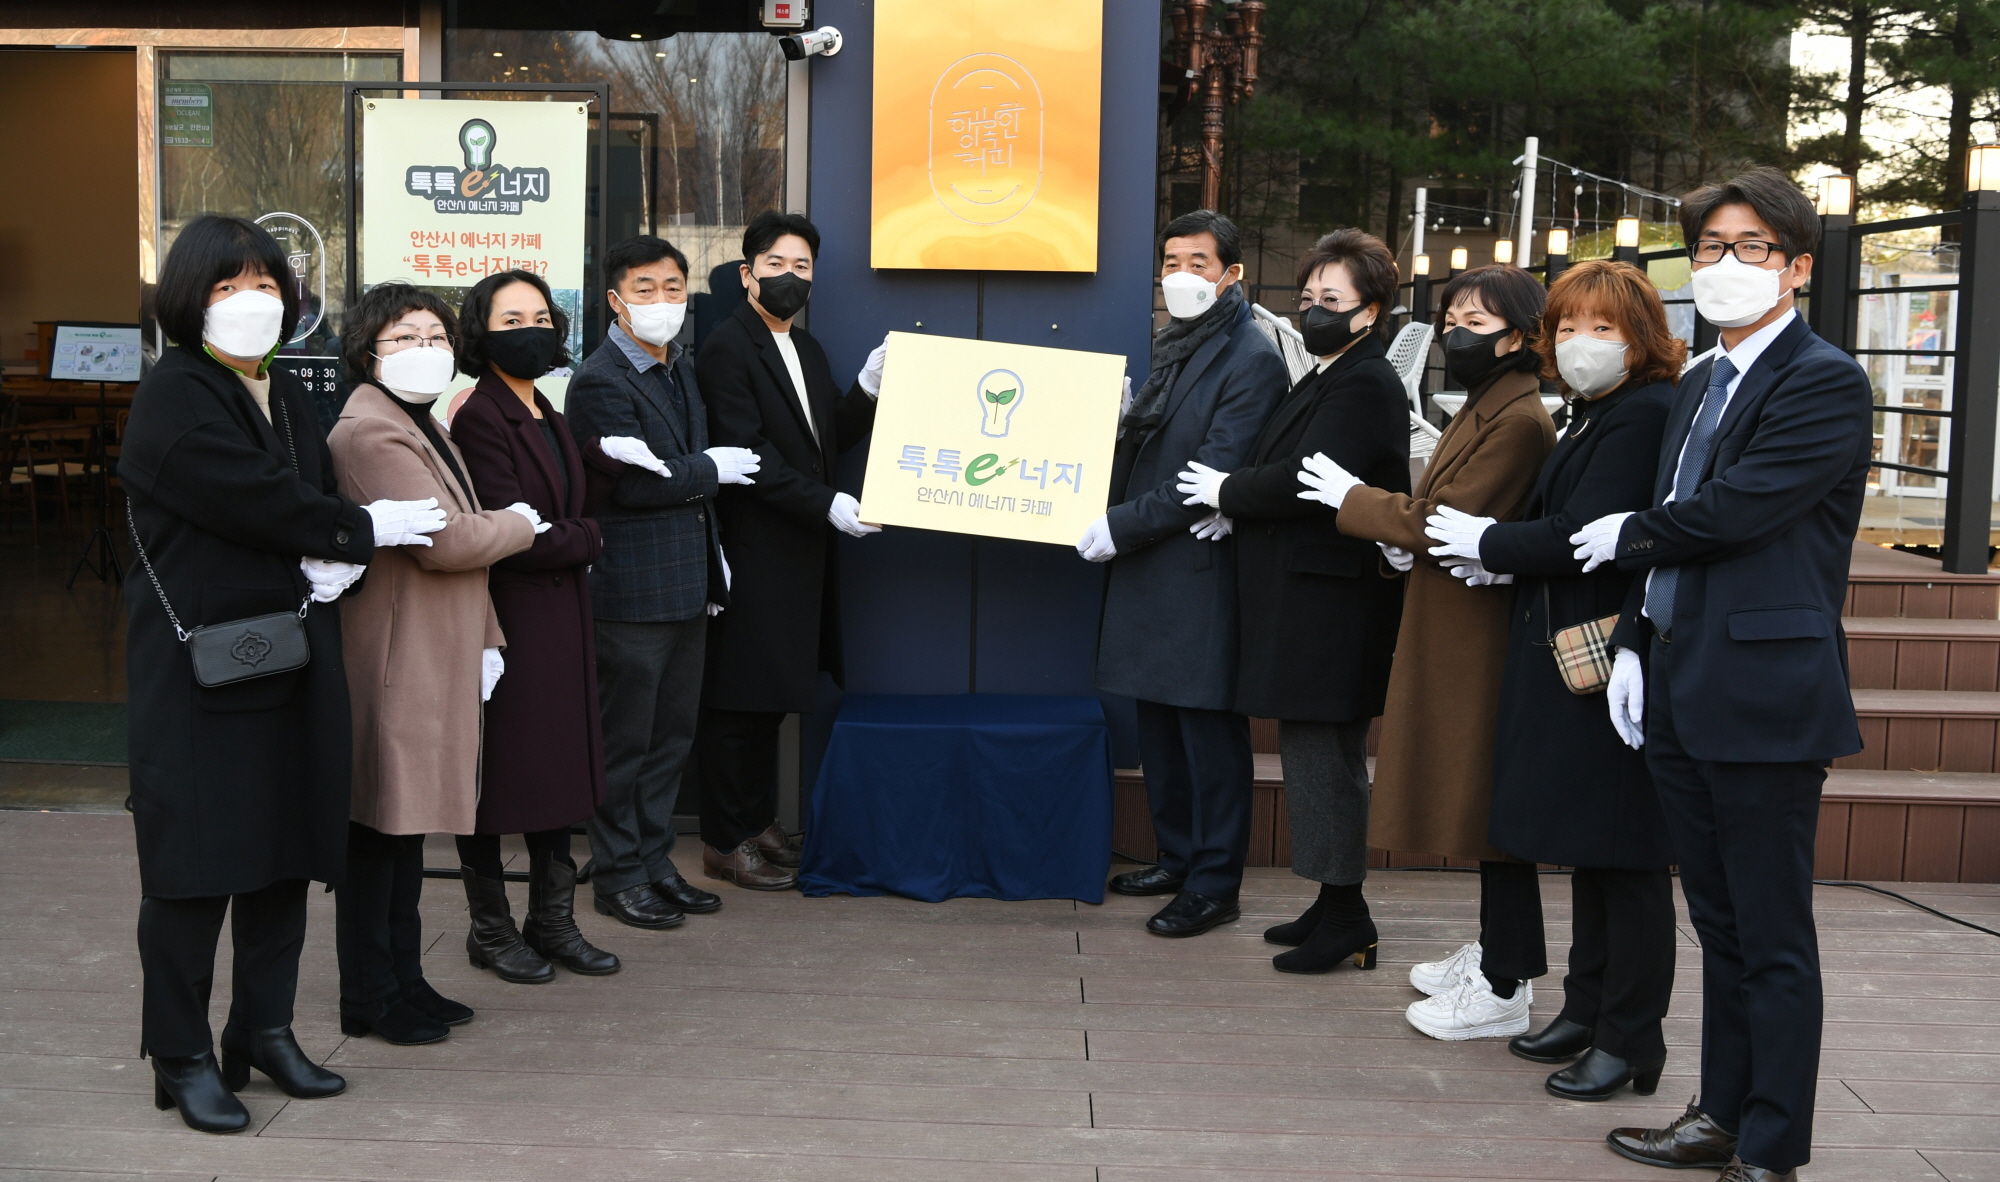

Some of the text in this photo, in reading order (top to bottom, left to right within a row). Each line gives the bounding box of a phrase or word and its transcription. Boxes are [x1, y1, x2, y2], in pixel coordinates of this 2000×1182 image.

[171, 96, 203, 105] members
[437, 199, 520, 212] 안산시 에너지 카페
[410, 231, 541, 250] 안산시 에너지 카페
[917, 486, 1053, 517] 안산시 에너지 카페
